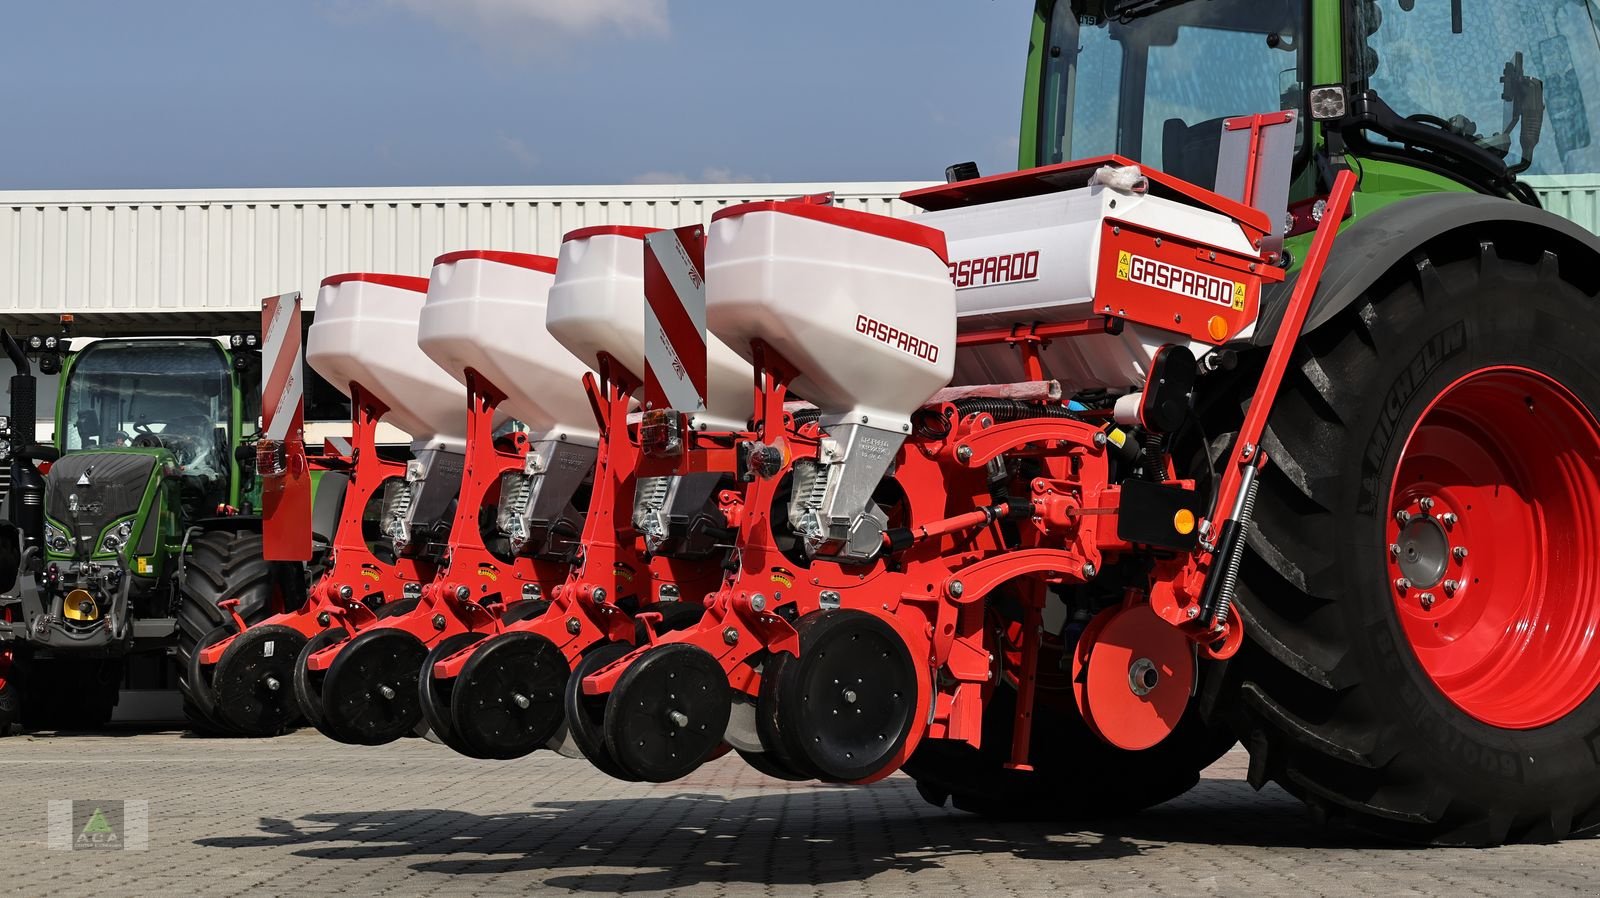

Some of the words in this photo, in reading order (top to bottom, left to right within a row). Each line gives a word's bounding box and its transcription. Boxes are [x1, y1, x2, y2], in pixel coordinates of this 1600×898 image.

[948, 250, 1040, 288] ASPARDO
[1130, 257, 1233, 305] GASPARDO
[855, 314, 939, 363] GASPARDO
[1367, 320, 1466, 473] MICHELIN
